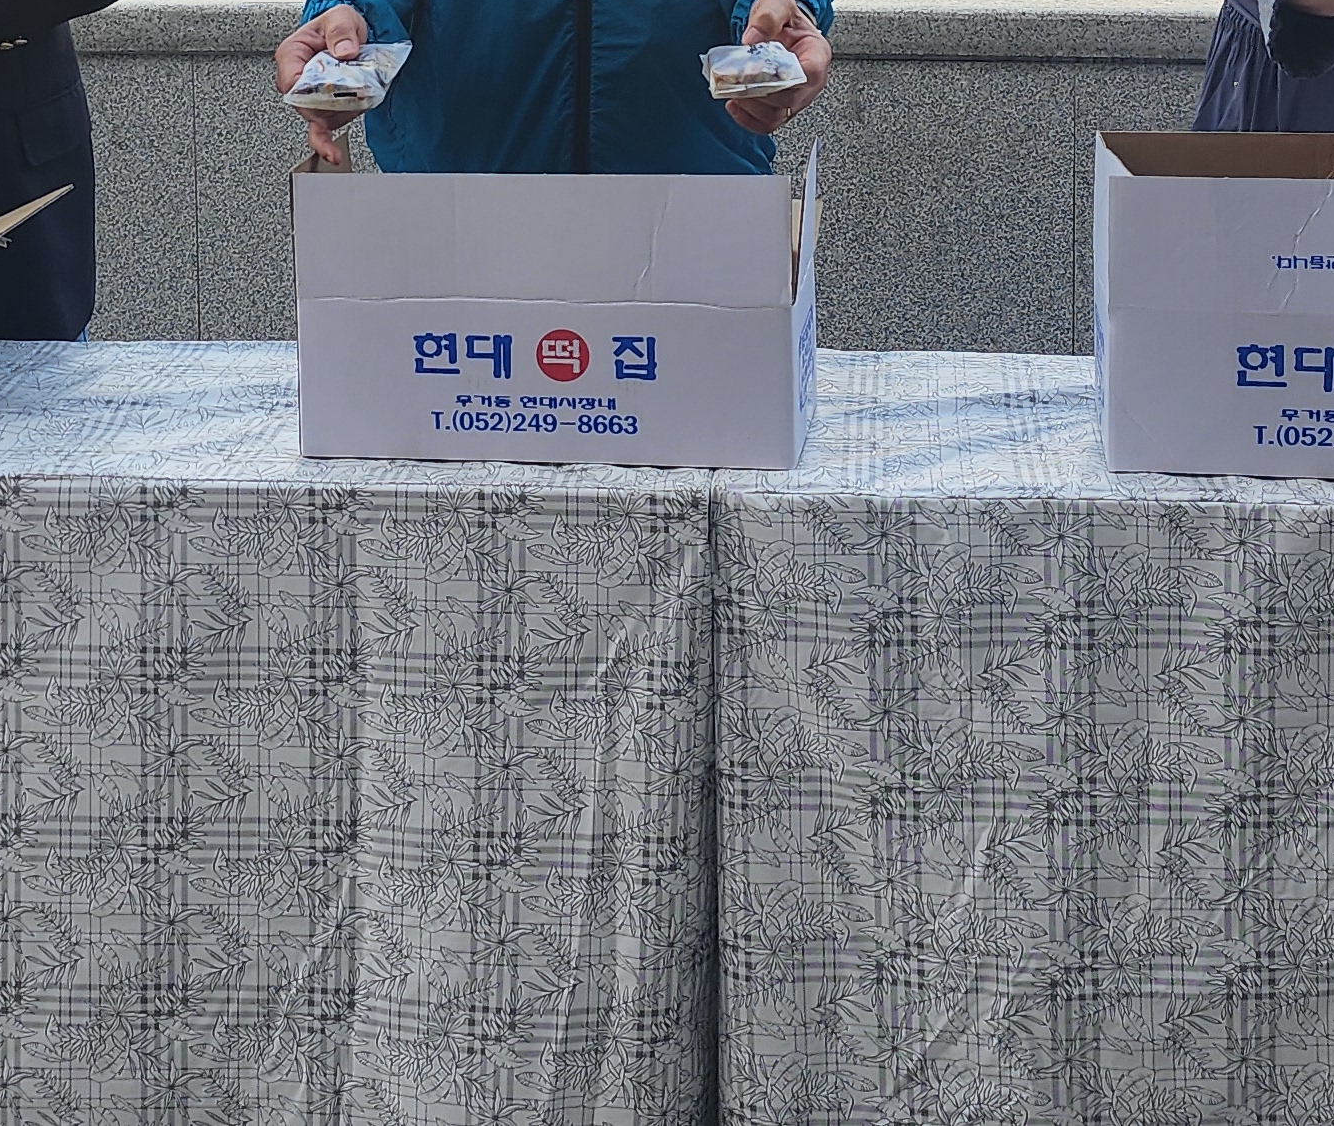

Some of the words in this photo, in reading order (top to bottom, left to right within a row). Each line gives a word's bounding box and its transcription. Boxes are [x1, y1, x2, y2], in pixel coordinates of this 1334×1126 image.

[413, 333, 513, 379] 현대
[540, 338, 582, 374] 떡
[612, 337, 657, 380] 집
[455, 395, 511, 408] 무거동
[519, 396, 616, 410] 현대시장내
[431, 410, 638, 435] T.(052)249-8663
